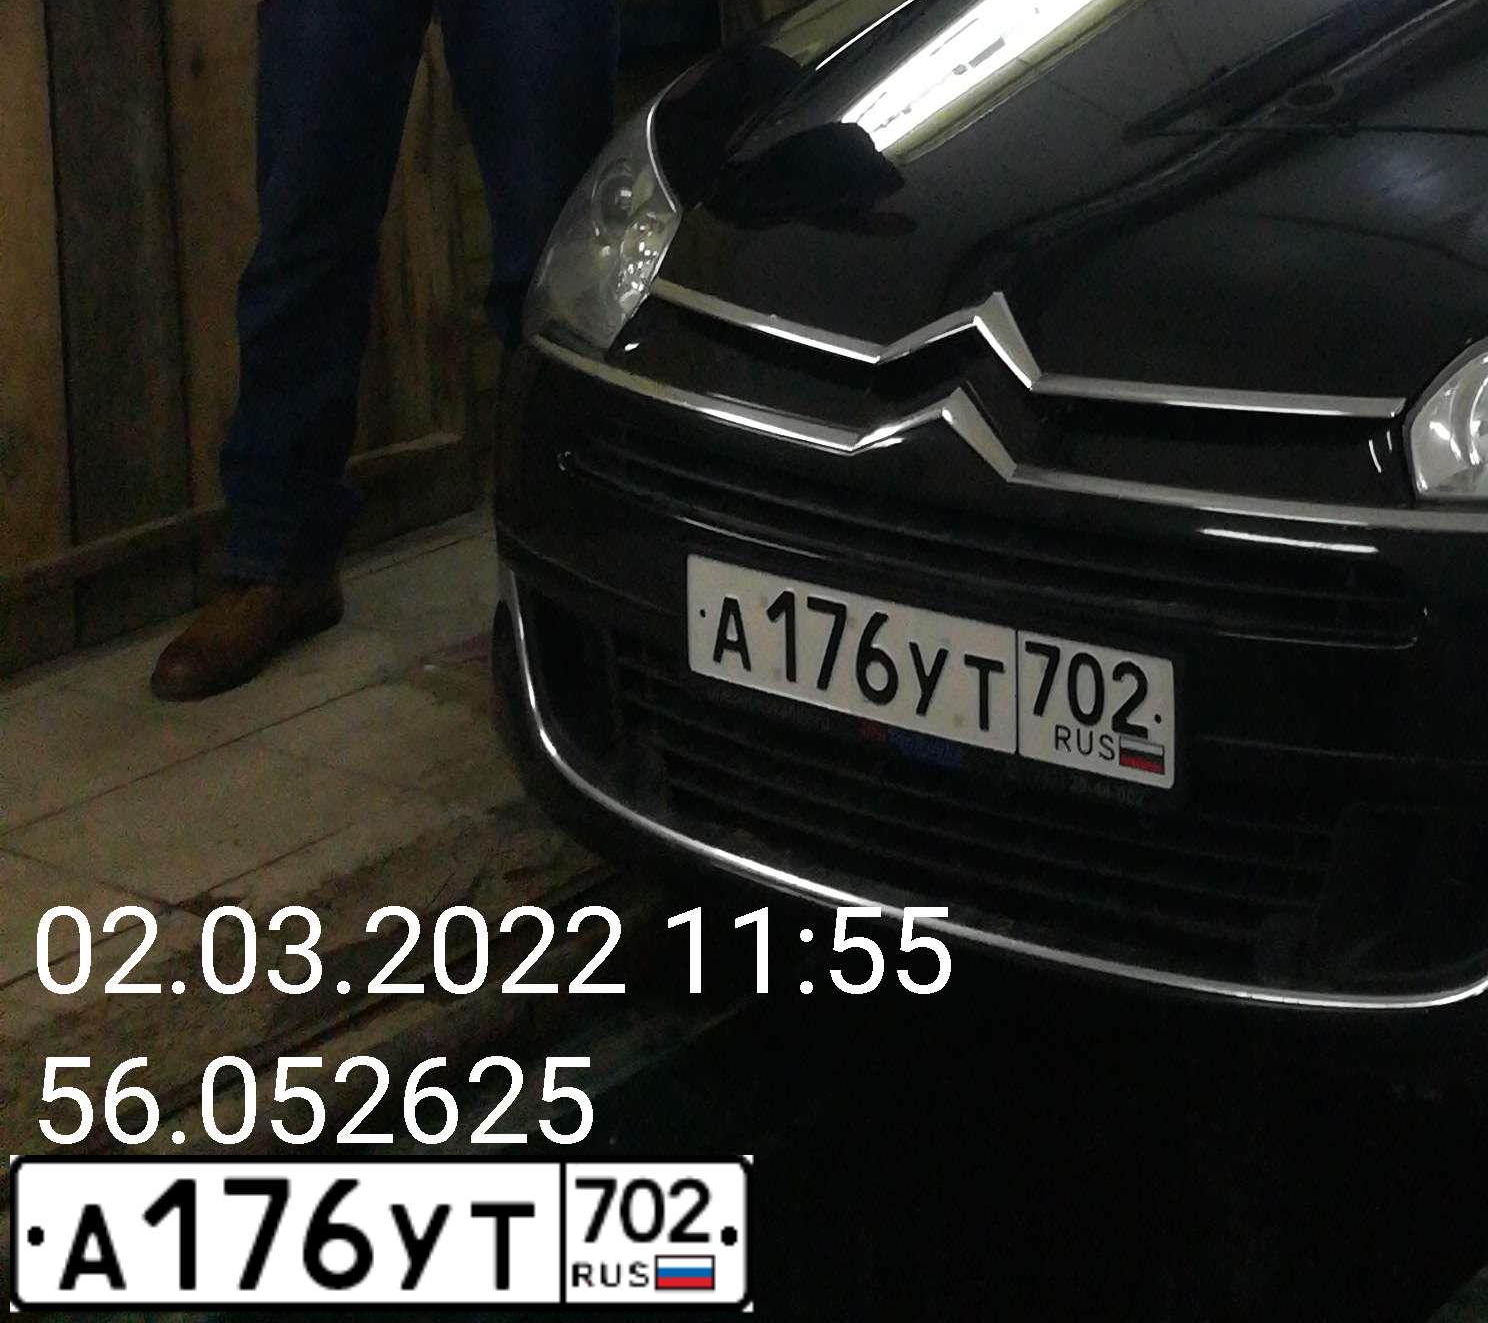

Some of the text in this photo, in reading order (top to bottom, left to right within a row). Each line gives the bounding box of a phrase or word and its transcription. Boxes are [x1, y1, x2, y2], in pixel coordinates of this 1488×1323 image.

[712, 590, 1005, 732] А176УТ
[1024, 640, 1150, 740] 702
[1054, 724, 1116, 761] RUS
